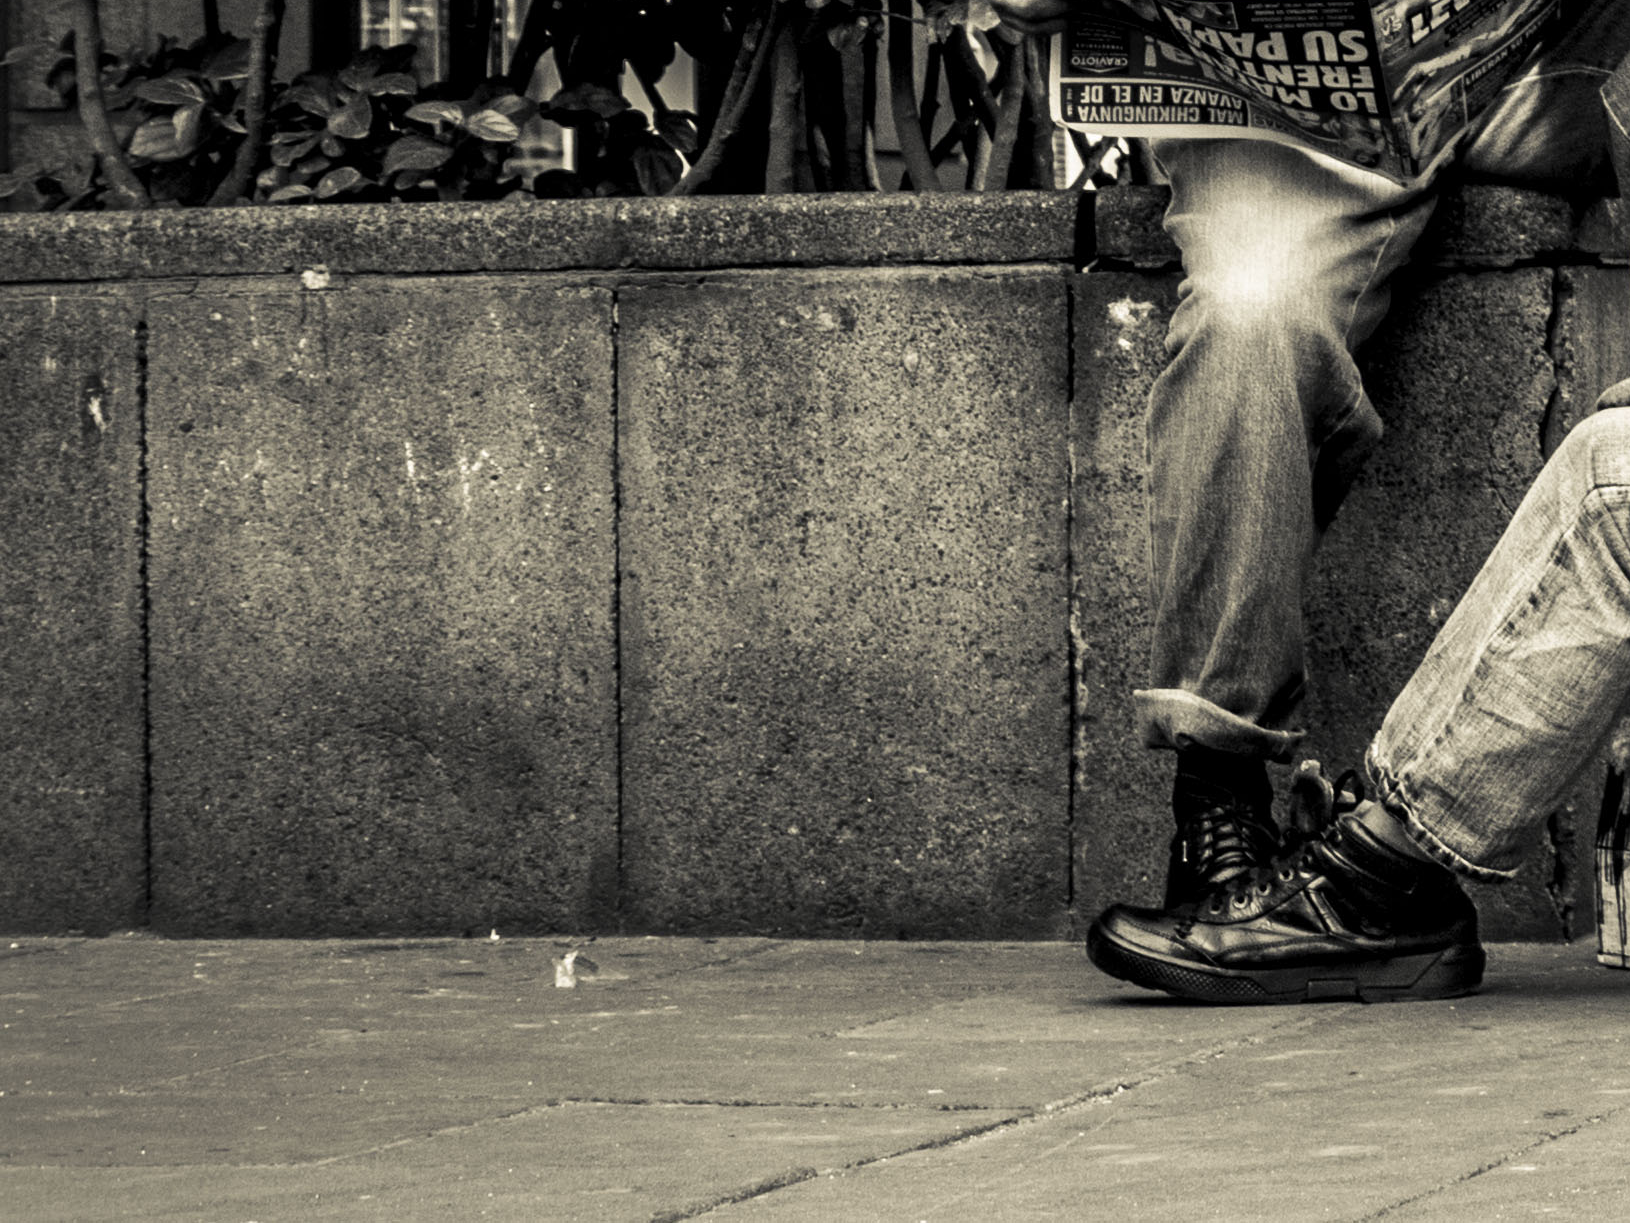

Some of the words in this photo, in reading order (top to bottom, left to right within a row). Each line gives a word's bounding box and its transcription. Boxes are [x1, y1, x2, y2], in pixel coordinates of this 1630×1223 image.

[1302, 29, 1369, 63] SU
[1071, 56, 1129, 67] CRAVIOTO
[1079, 85, 1104, 103] DF
[1111, 85, 1131, 104] EL
[1140, 85, 1163, 104] EN
[1170, 86, 1243, 110] AVANZA
[1330, 90, 1379, 114] LO
[1077, 105, 1201, 124] CHIKUNGUNYA
[1206, 107, 1244, 125] MAL
